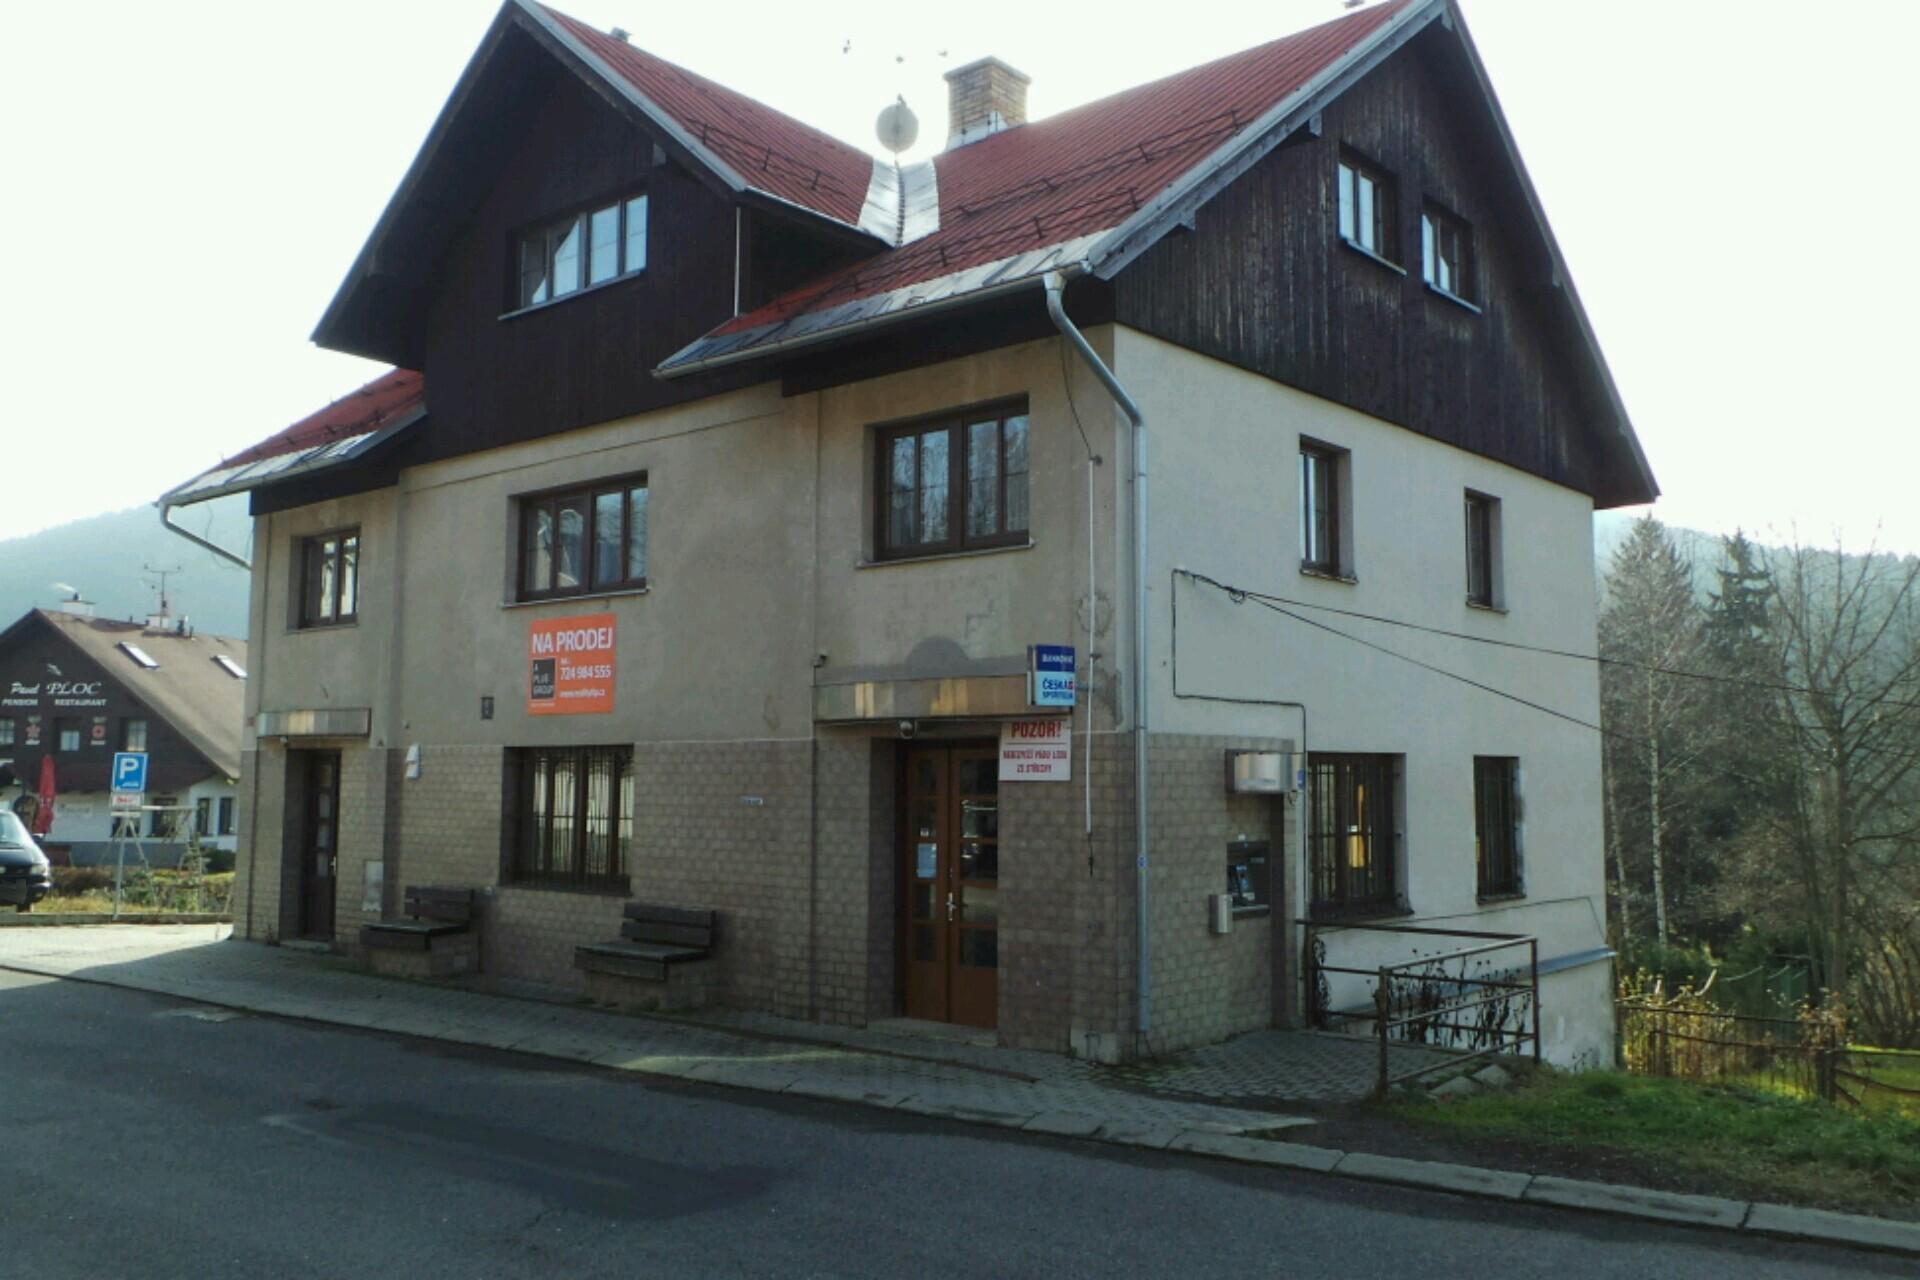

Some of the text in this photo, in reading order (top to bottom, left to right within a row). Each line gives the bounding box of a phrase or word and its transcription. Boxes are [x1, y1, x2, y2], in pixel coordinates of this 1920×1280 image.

[532, 627, 613, 654] NA PRODEJ
[1011, 721, 1061, 738] POZOR!
[120, 758, 139, 779] P
